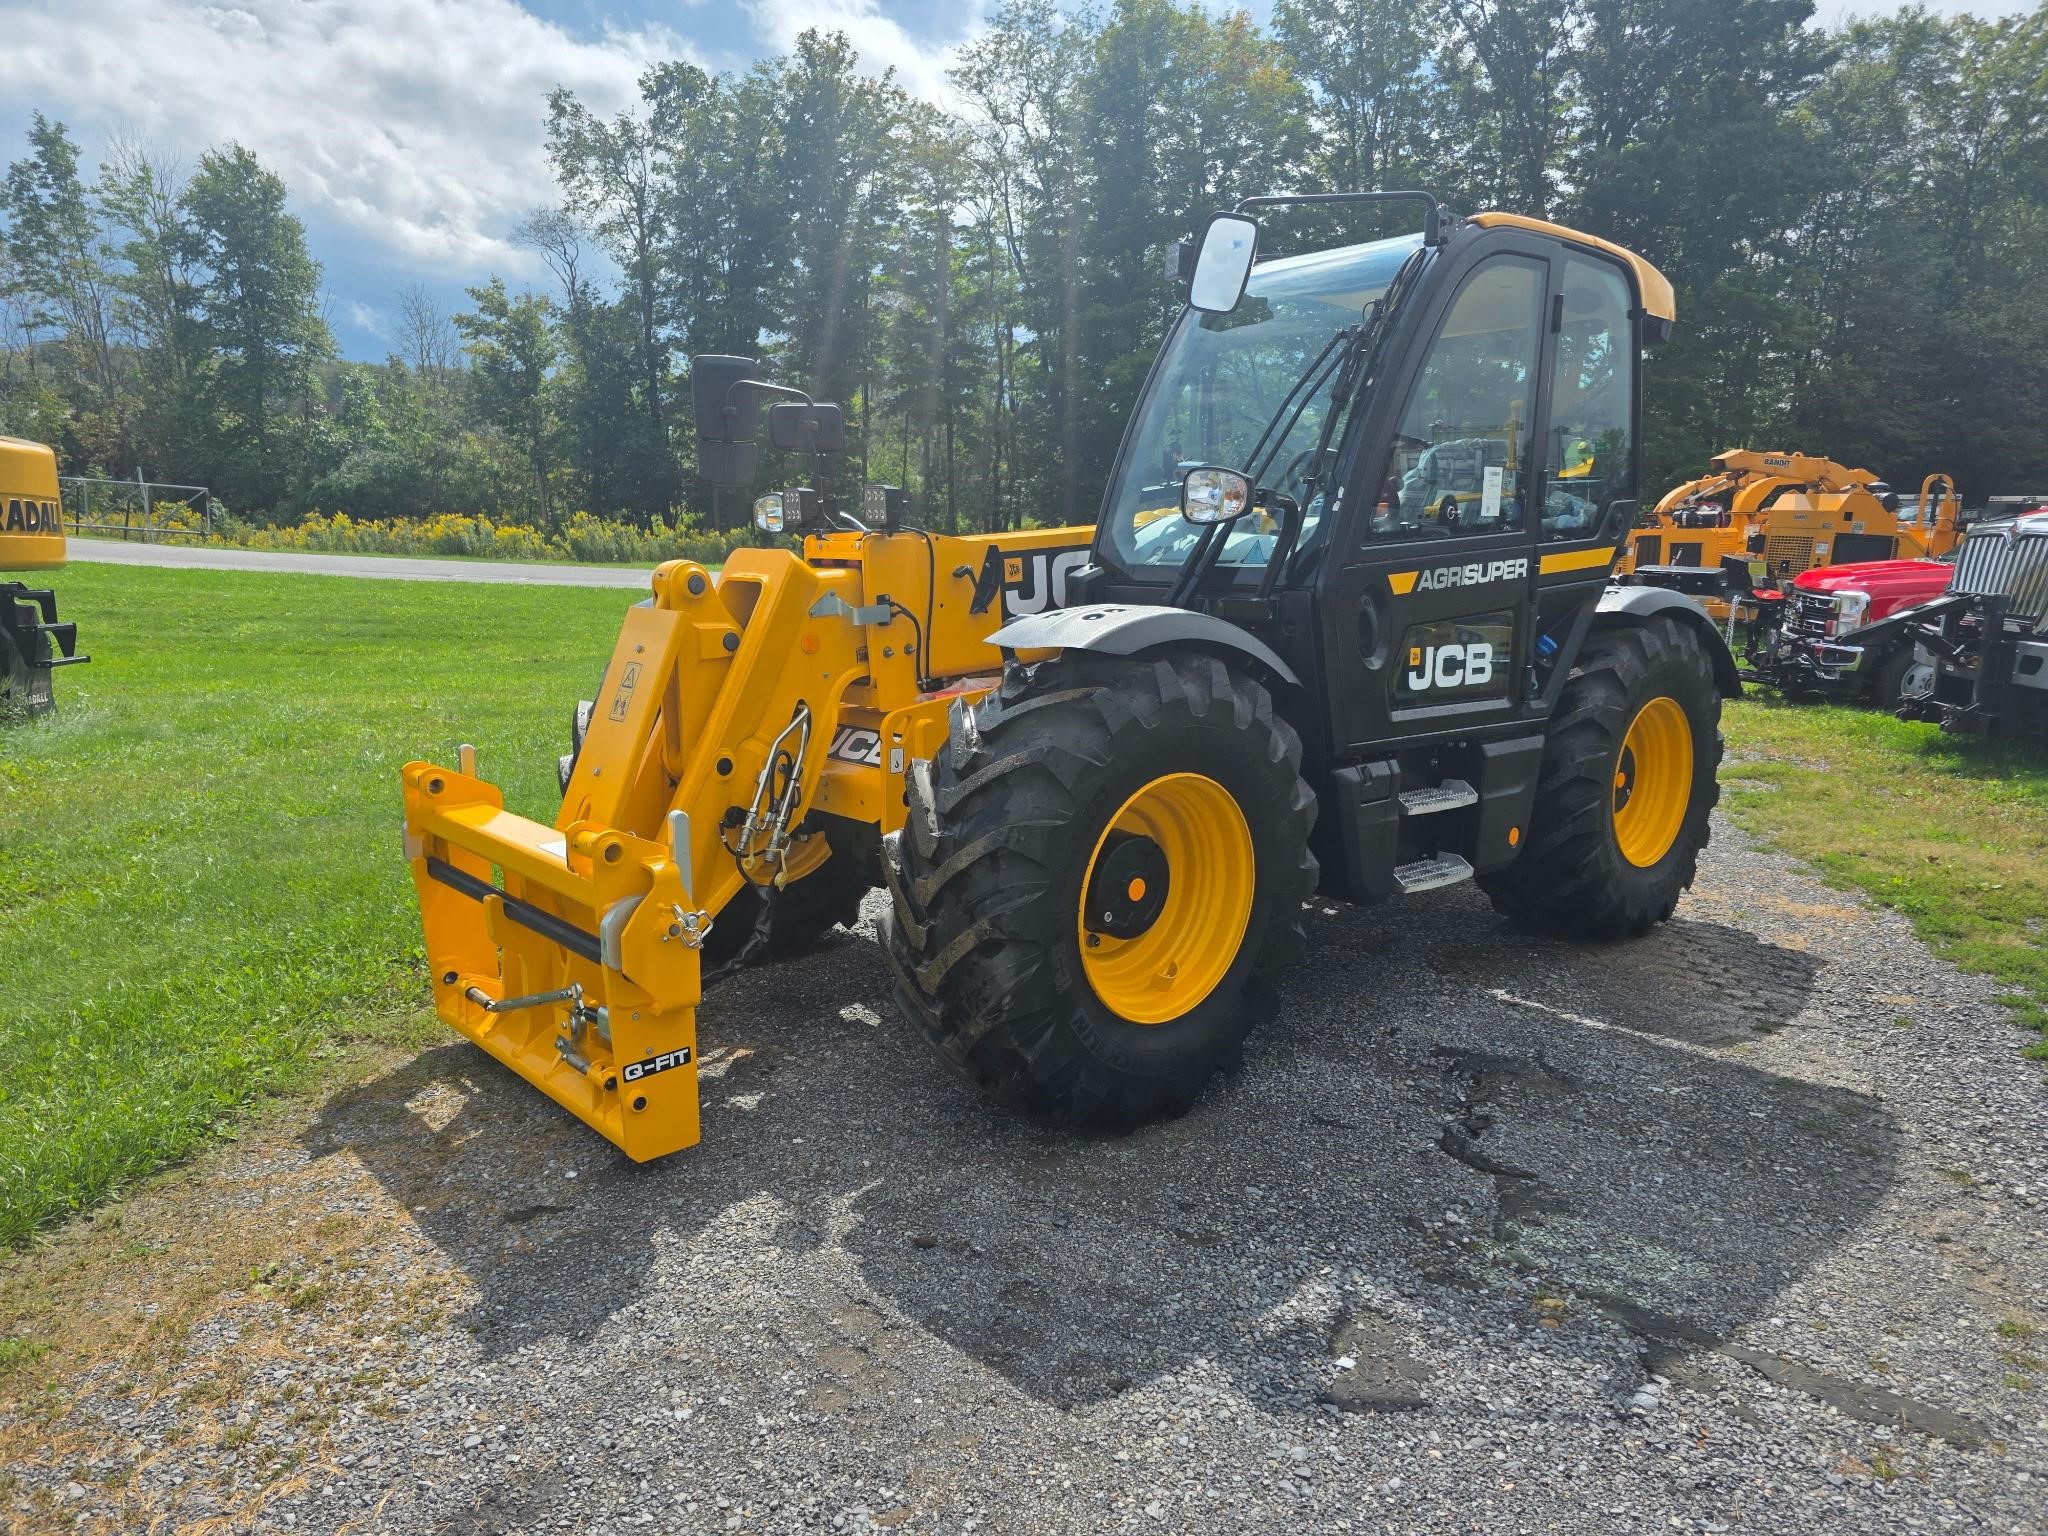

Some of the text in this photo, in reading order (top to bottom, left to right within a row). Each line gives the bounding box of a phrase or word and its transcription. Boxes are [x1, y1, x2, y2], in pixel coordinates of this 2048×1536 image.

[1764, 458, 1792, 467] BANDIT
[1416, 558, 1528, 592] AGRISUPER
[1408, 643, 1492, 691] JCB
[624, 1048, 689, 1081] Q-FIT
